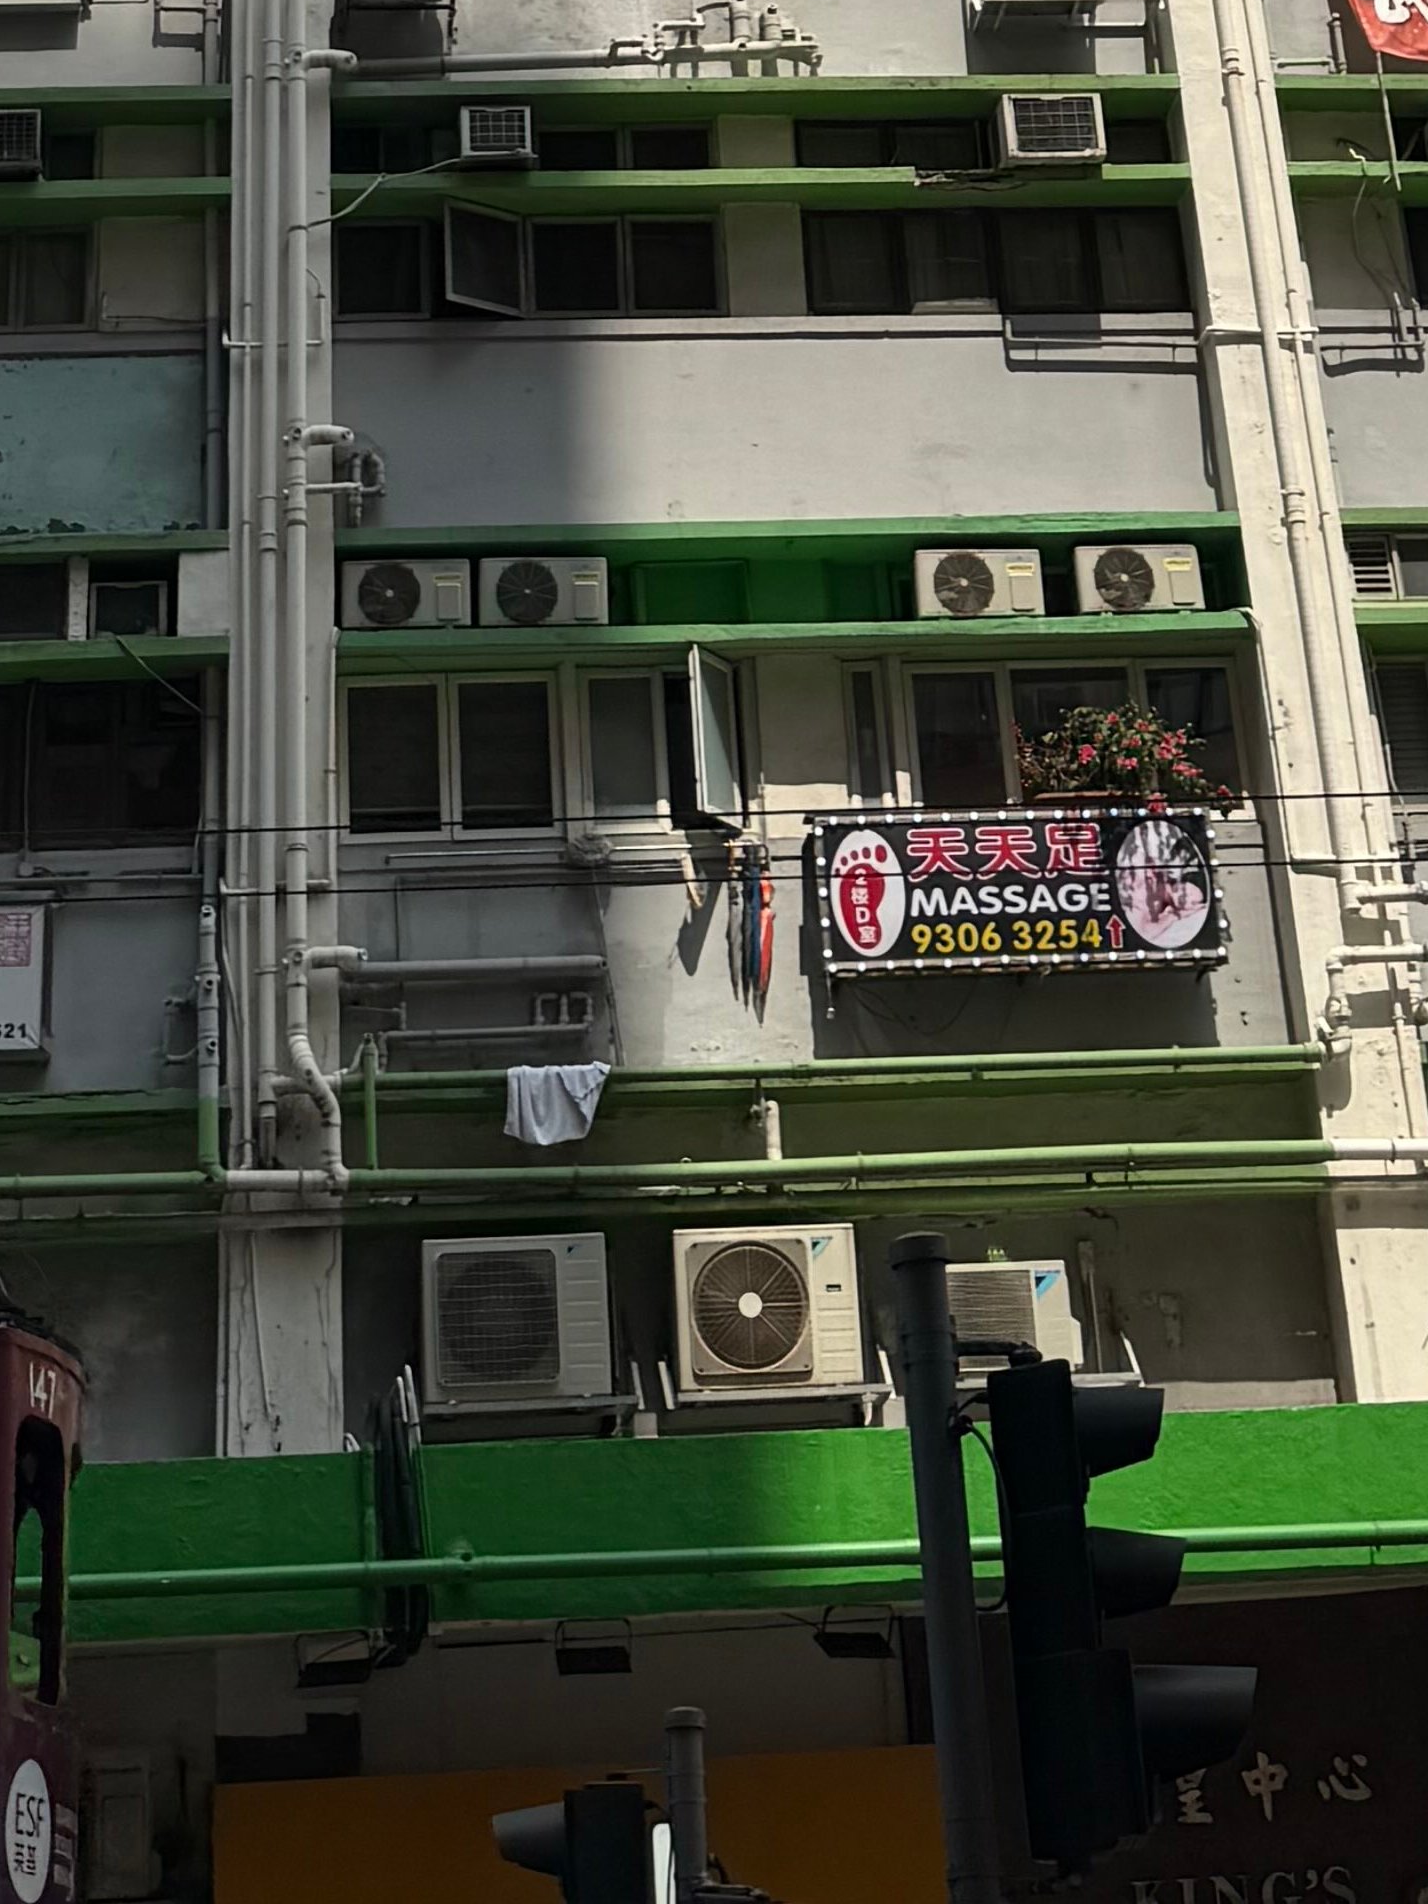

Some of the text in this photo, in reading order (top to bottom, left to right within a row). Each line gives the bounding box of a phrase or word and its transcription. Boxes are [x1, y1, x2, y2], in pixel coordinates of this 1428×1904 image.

[906, 822, 1109, 882] 天天足
[910, 882, 1112, 918] MASSAGE
[910, 918, 1104, 954] 9306 3254
[15, 1793, 46, 1838] ESF
